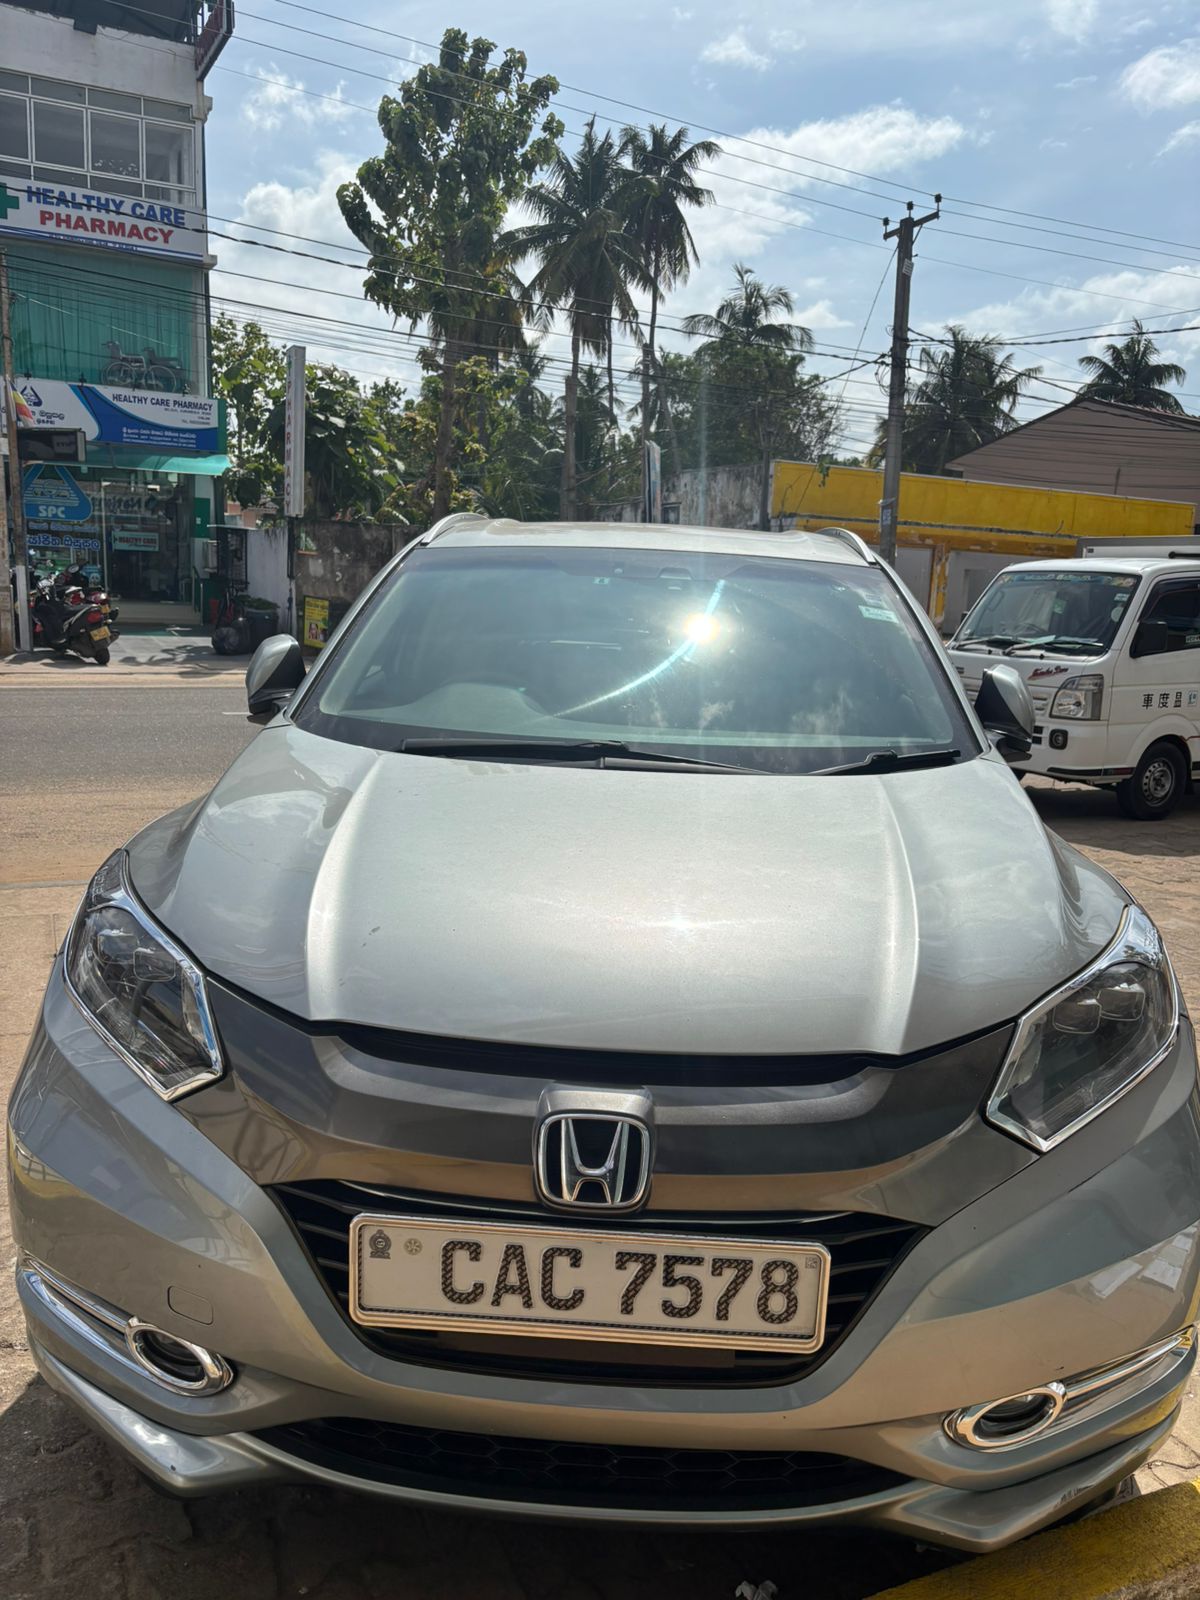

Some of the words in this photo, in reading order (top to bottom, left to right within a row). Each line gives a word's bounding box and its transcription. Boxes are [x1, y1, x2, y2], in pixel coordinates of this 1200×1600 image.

[27, 186, 125, 215] HEALTHY
[131, 203, 186, 226] CARE
[39, 210, 174, 244] PHARMACY
[112, 393, 149, 406] HEALTHY
[150, 397, 173, 408] CARE
[173, 400, 213, 412] PHARMACY
[38, 505, 66, 518] SPC
[441, 1240, 585, 1311] CAC
[615, 1251, 800, 1325] 7578
